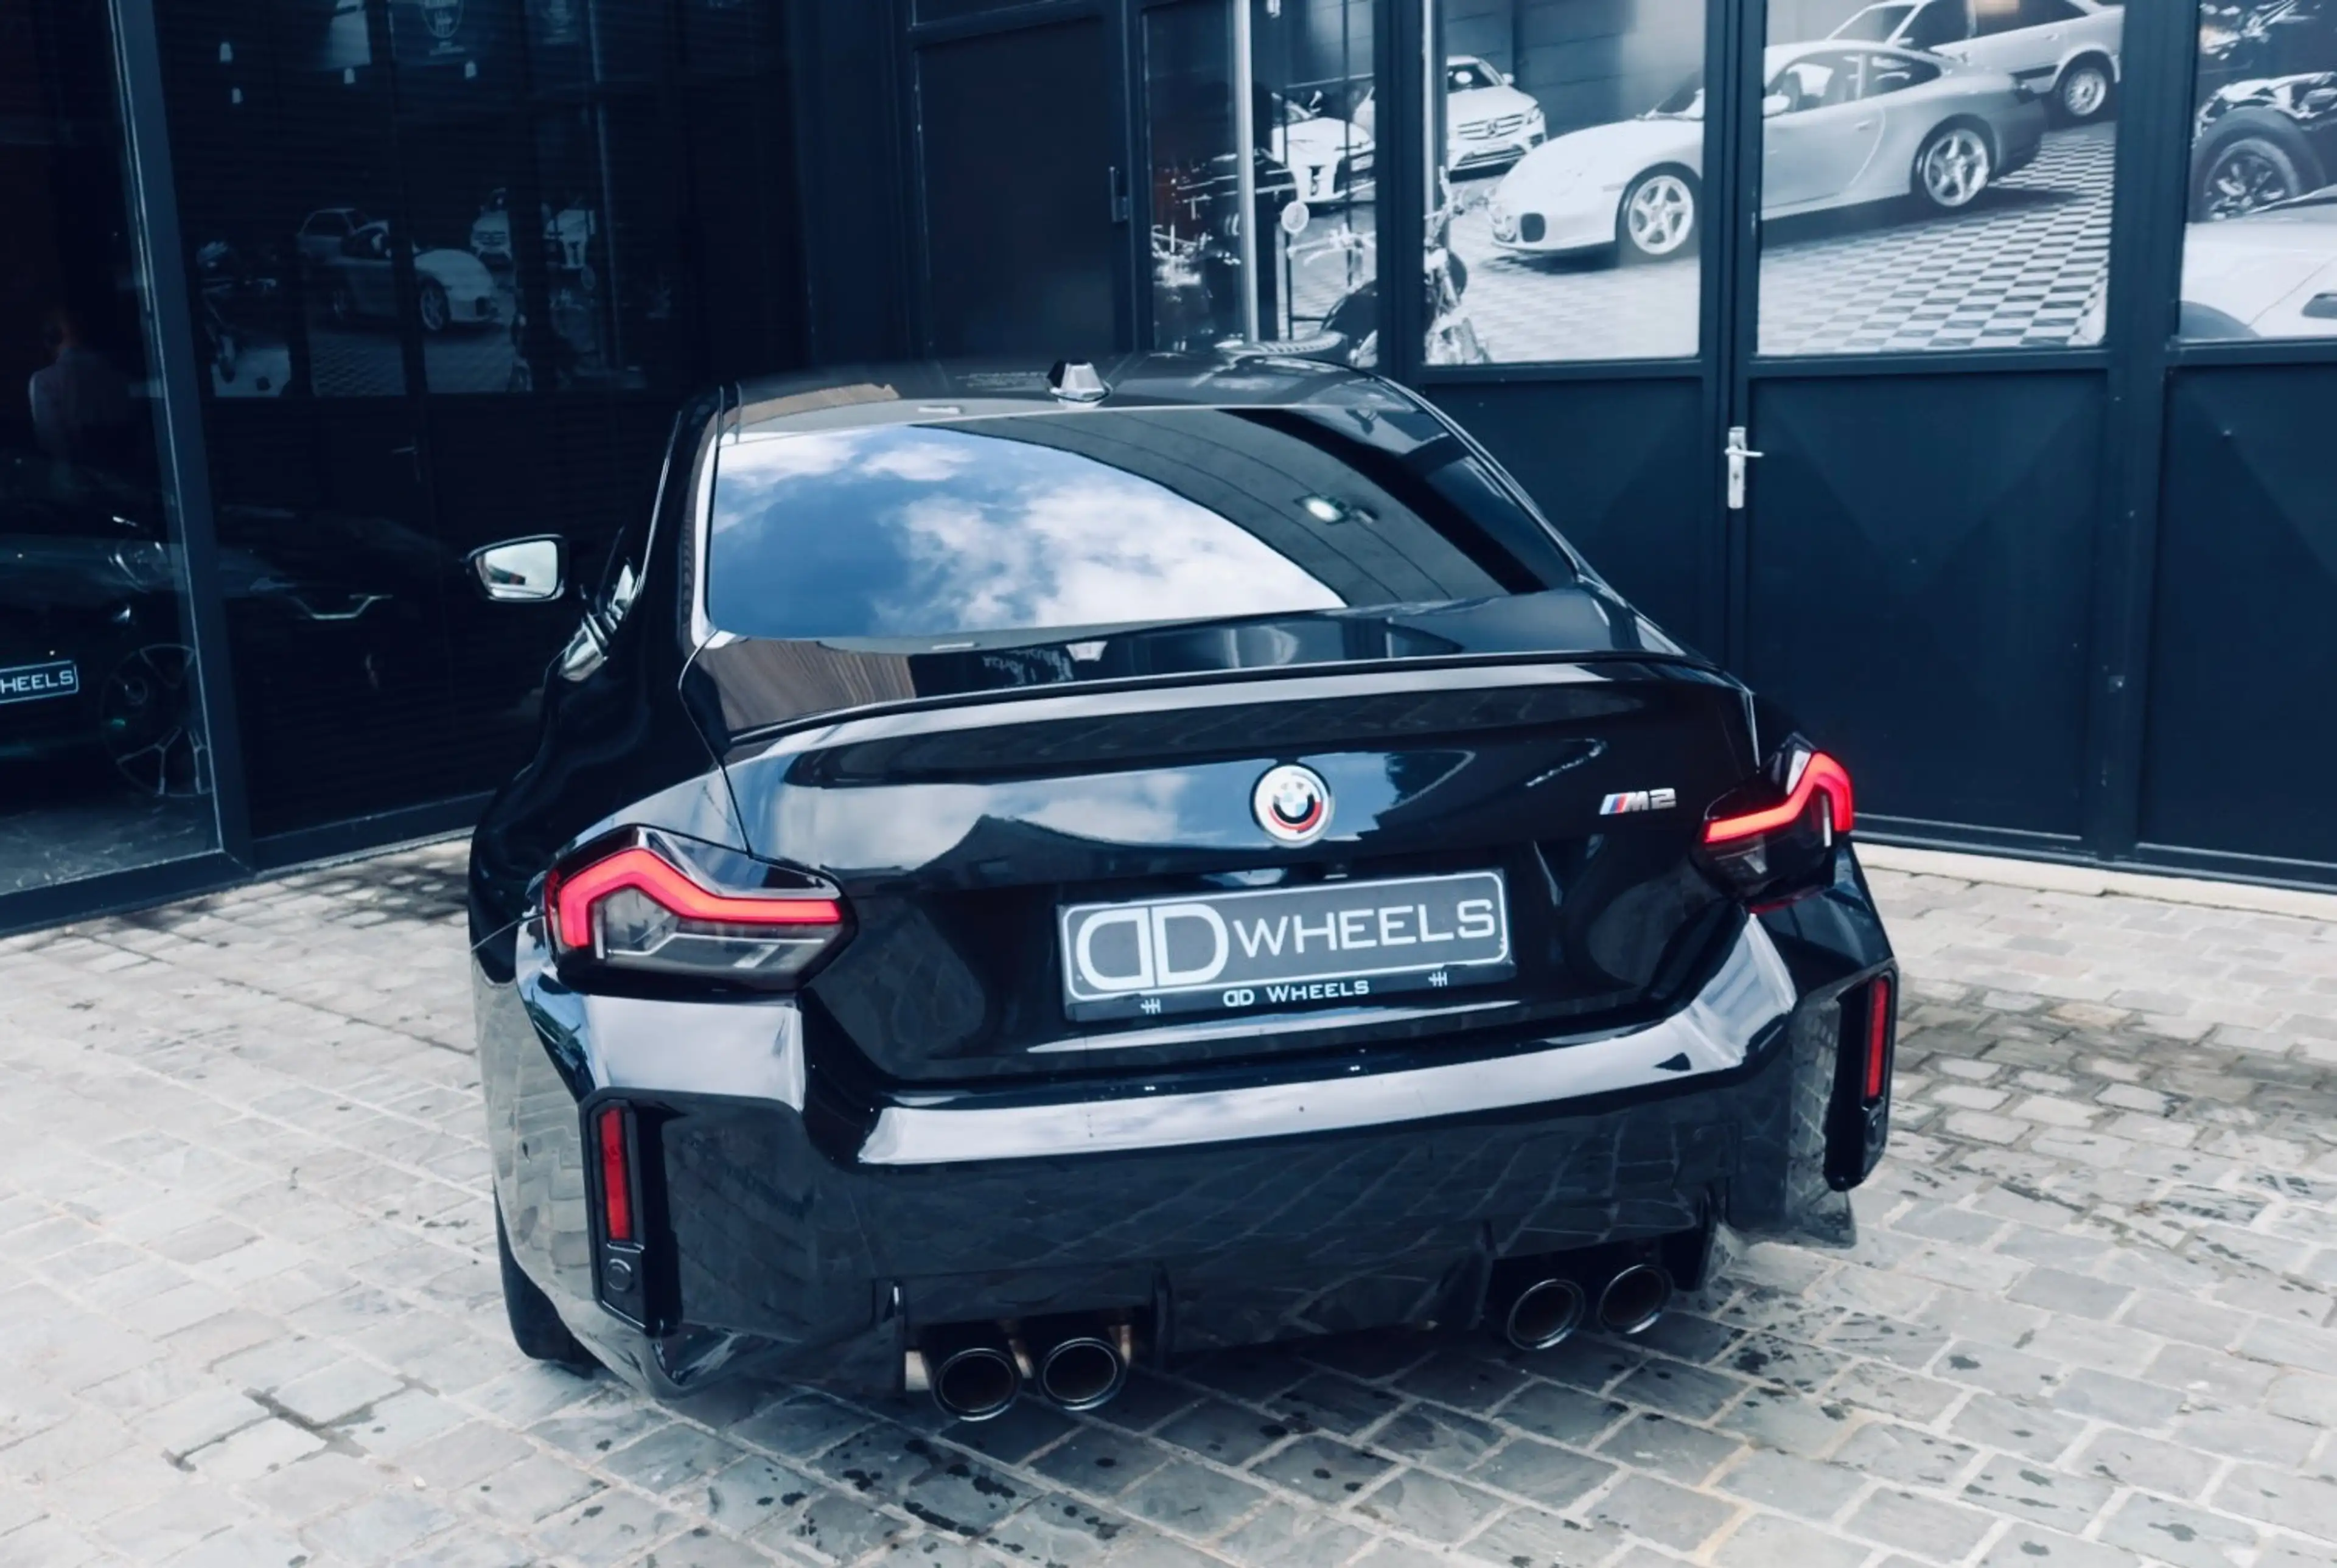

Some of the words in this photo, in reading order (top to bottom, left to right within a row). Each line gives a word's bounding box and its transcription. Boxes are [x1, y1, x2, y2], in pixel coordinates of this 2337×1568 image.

[0, 670, 74, 694] HEELS
[1599, 787, 1676, 815] M2
[1232, 899, 1495, 958] WHEELS
